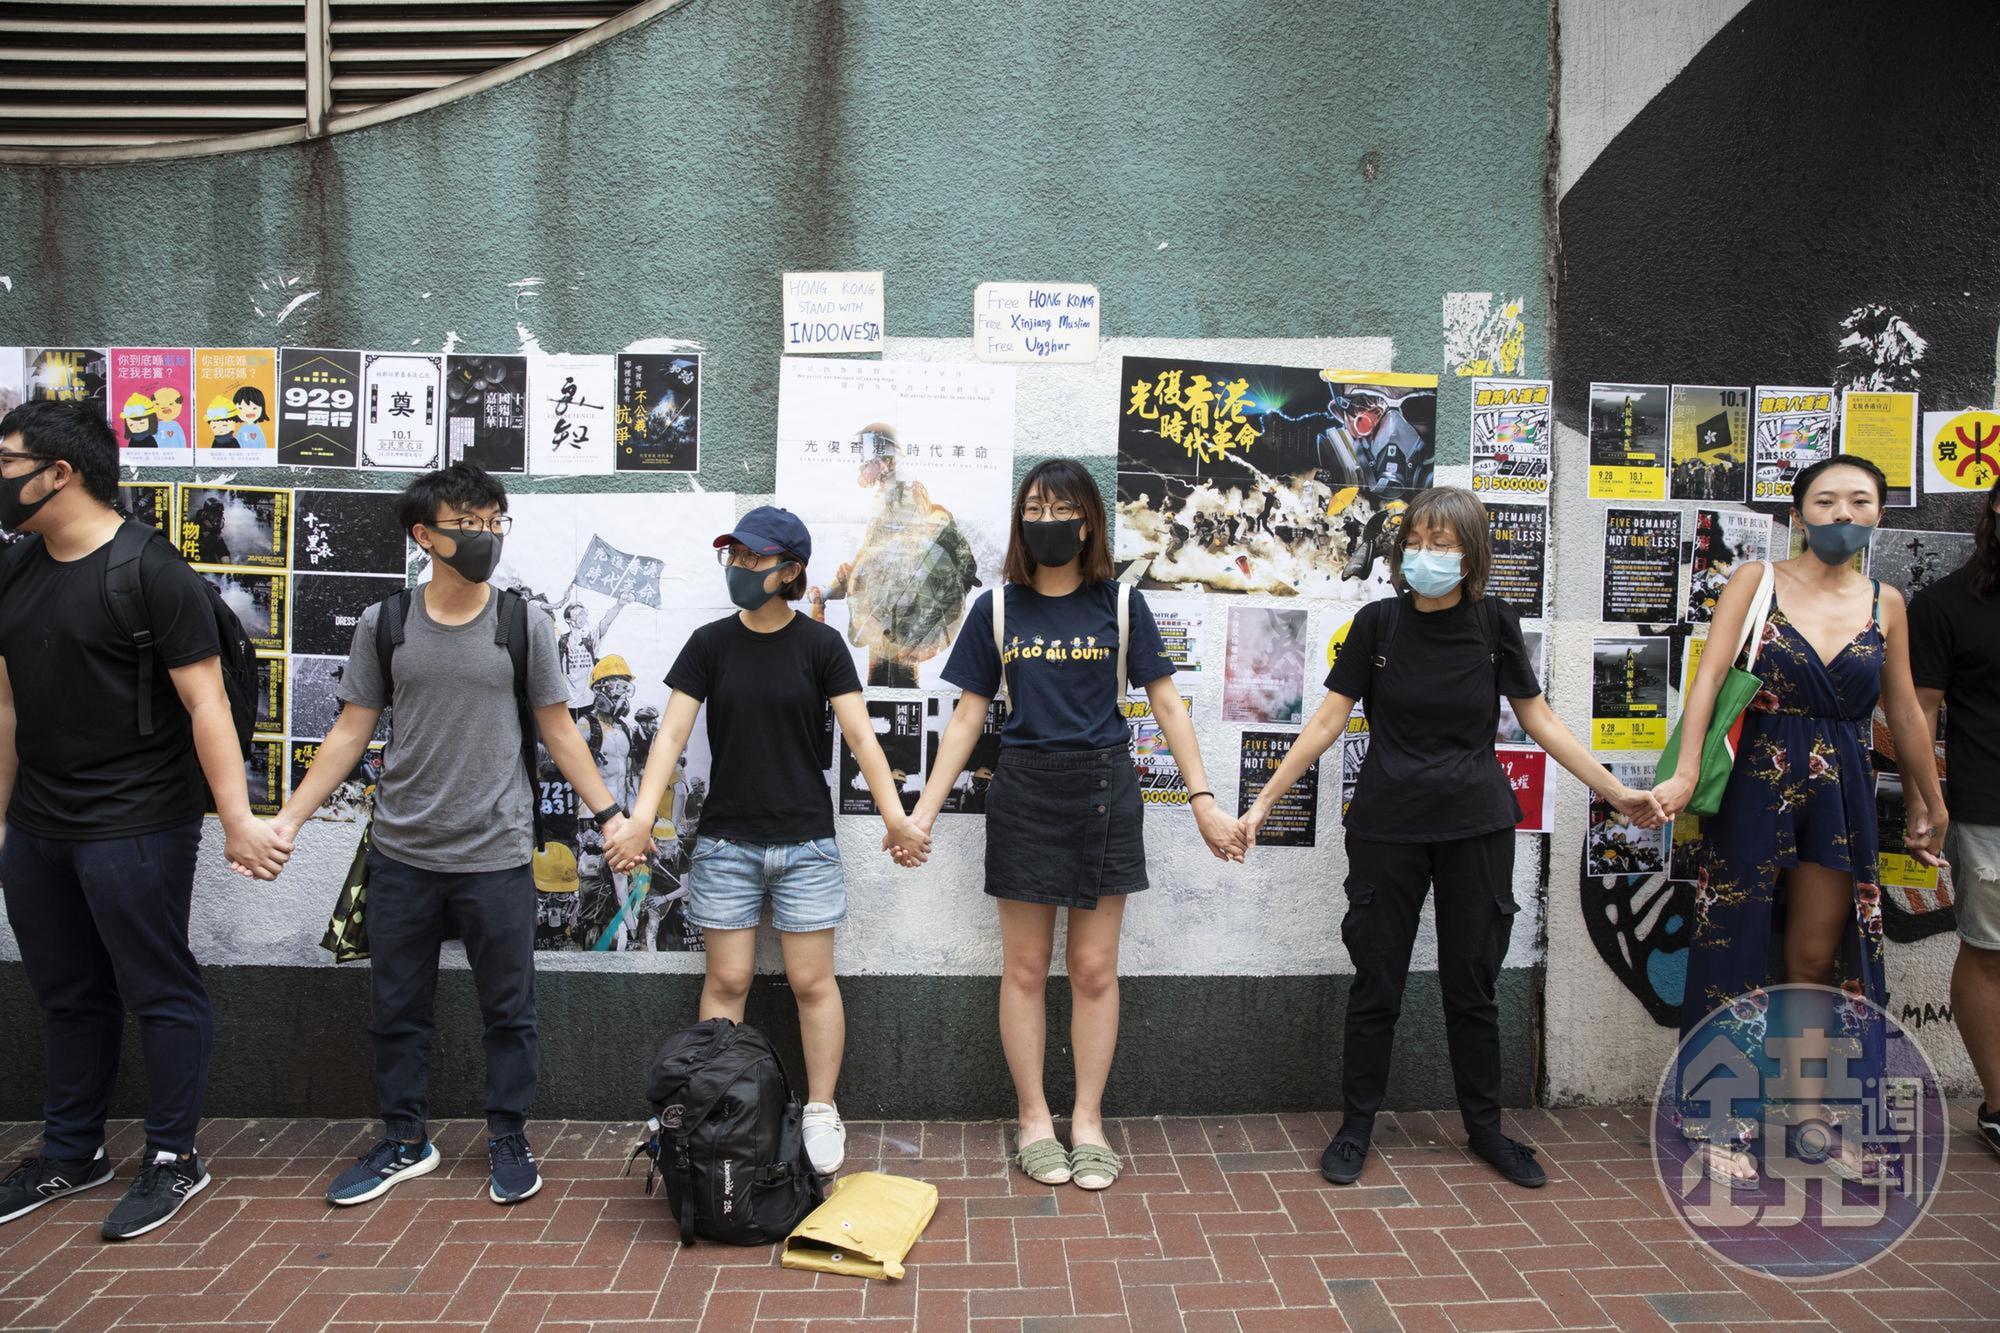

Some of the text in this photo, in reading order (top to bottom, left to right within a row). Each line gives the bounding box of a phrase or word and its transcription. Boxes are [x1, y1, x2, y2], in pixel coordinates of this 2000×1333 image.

[789, 280, 876, 296] HONG KONG
[987, 289, 1095, 309] Free HONG KONG
[798, 300, 864, 315] STAND WITH
[978, 314, 1091, 332] Free Xinjiang Muslim
[790, 321, 880, 343] INDONESIA
[987, 336, 1072, 356] Free Uyghur
[285, 387, 354, 409] 929
[388, 391, 415, 418] 奠
[1126, 369, 1257, 429] 光復香港
[1720, 390, 1747, 408] 10.1
[392, 430, 411, 440] 10.1
[1160, 414, 1262, 463] 時代革命
[906, 443, 989, 459] 時代革命
[1938, 441, 1958, 461] 党
[1598, 470, 1613, 481] 9.28
[1629, 471, 1643, 482] 10.1
[1472, 475, 1548, 492] $1500000
[1498, 511, 1543, 523] DEMANDS
[1610, 517, 1678, 529] FIVE DEMANDS
[1737, 517, 1748, 527] WE
[1495, 529, 1516, 541] ONE
[1609, 535, 1628, 546] NOT
[1631, 535, 1650, 547] ONE
[1021, 645, 1042, 659] GO
[1046, 647, 1068, 660] ALL
[1071, 647, 1104, 660] OUT!
[1600, 723, 1616, 732] 9.28
[1631, 723, 1645, 732] 10.1
[293, 743, 320, 763] 光復
[1245, 740, 1268, 751] FIVE
[1244, 757, 1284, 770] NOT ON
